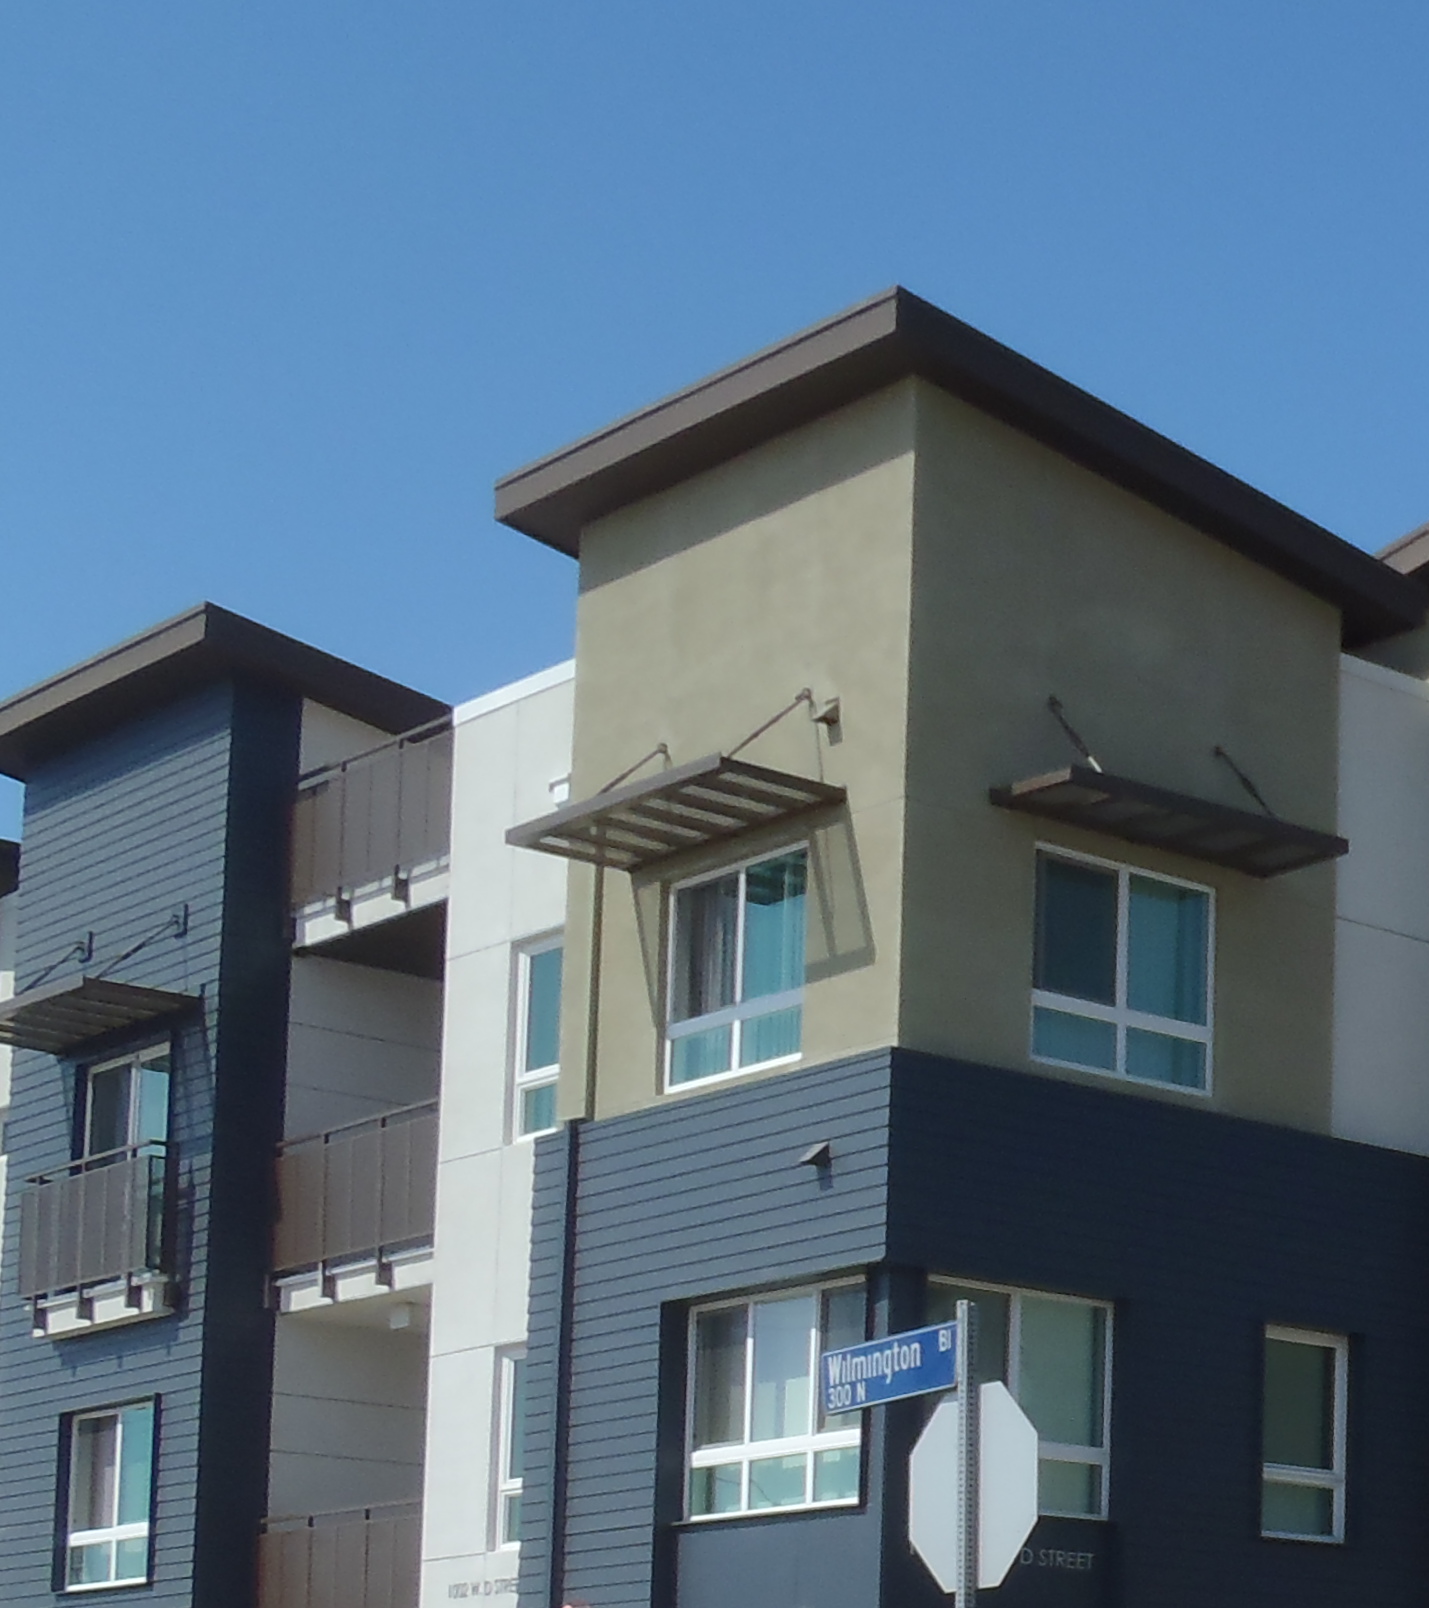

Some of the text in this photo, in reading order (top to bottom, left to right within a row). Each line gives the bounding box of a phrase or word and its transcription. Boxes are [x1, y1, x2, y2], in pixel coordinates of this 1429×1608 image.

[828, 1341, 921, 1384] Wilmington
[828, 1383, 866, 1409] 300 N
[1020, 1548, 1095, 1568] D STREET
